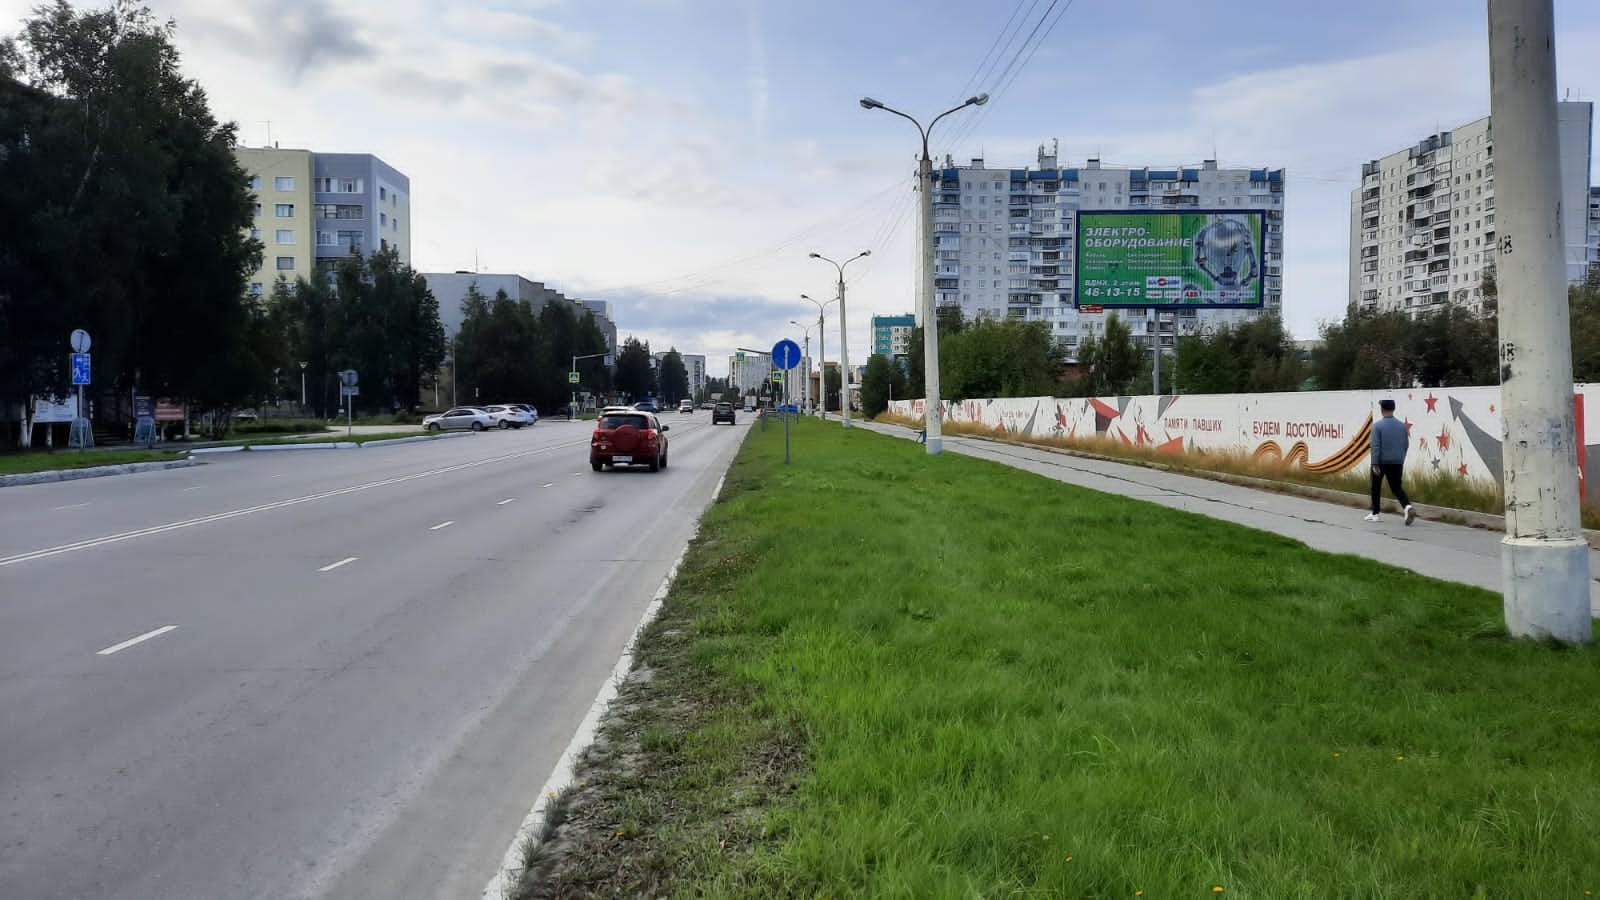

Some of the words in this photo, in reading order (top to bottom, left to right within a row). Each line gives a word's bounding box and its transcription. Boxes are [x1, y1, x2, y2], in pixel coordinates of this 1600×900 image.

[1085, 227, 1150, 237] ЭЛЕКТРО-
[1085, 238, 1192, 249] ОБОРУДОВАНИЕ
[1084, 287, 1141, 297] 48-13-15
[1164, 417, 1188, 429] ПАМЯТИ
[1192, 418, 1222, 432] ПАВШИХ
[1253, 421, 1281, 436] БУДЕМ
[1286, 421, 1344, 439] ДОСТОЙНЫ!
